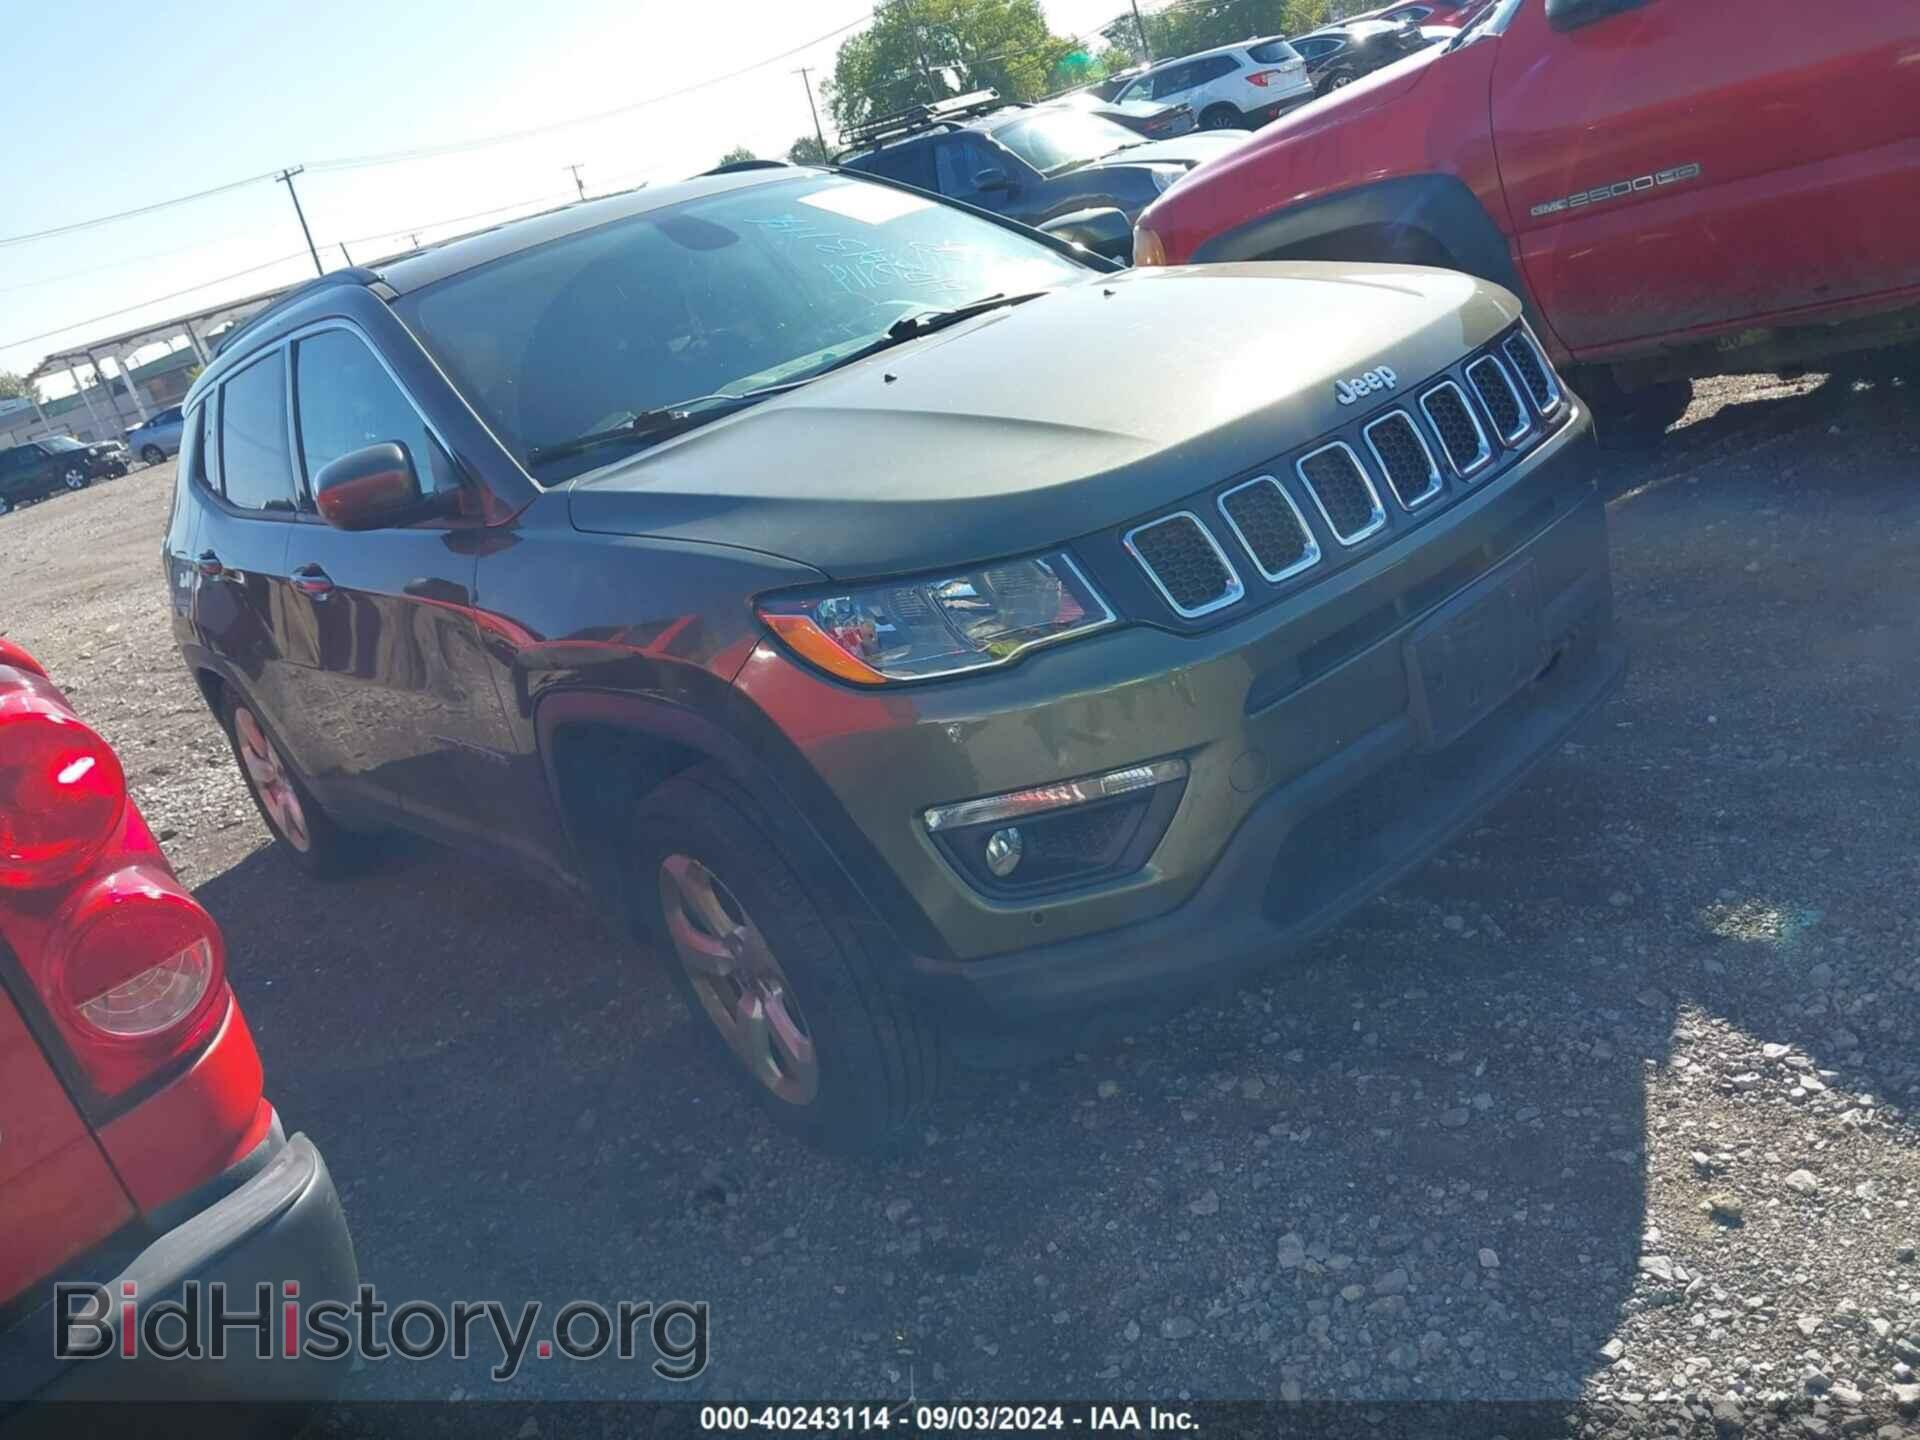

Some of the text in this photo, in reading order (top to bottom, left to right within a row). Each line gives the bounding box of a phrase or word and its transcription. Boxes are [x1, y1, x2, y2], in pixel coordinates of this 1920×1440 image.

[1530, 199, 1568, 217] GMC
[1568, 175, 1654, 207] 2500
[1335, 365, 1397, 405] Jeep
